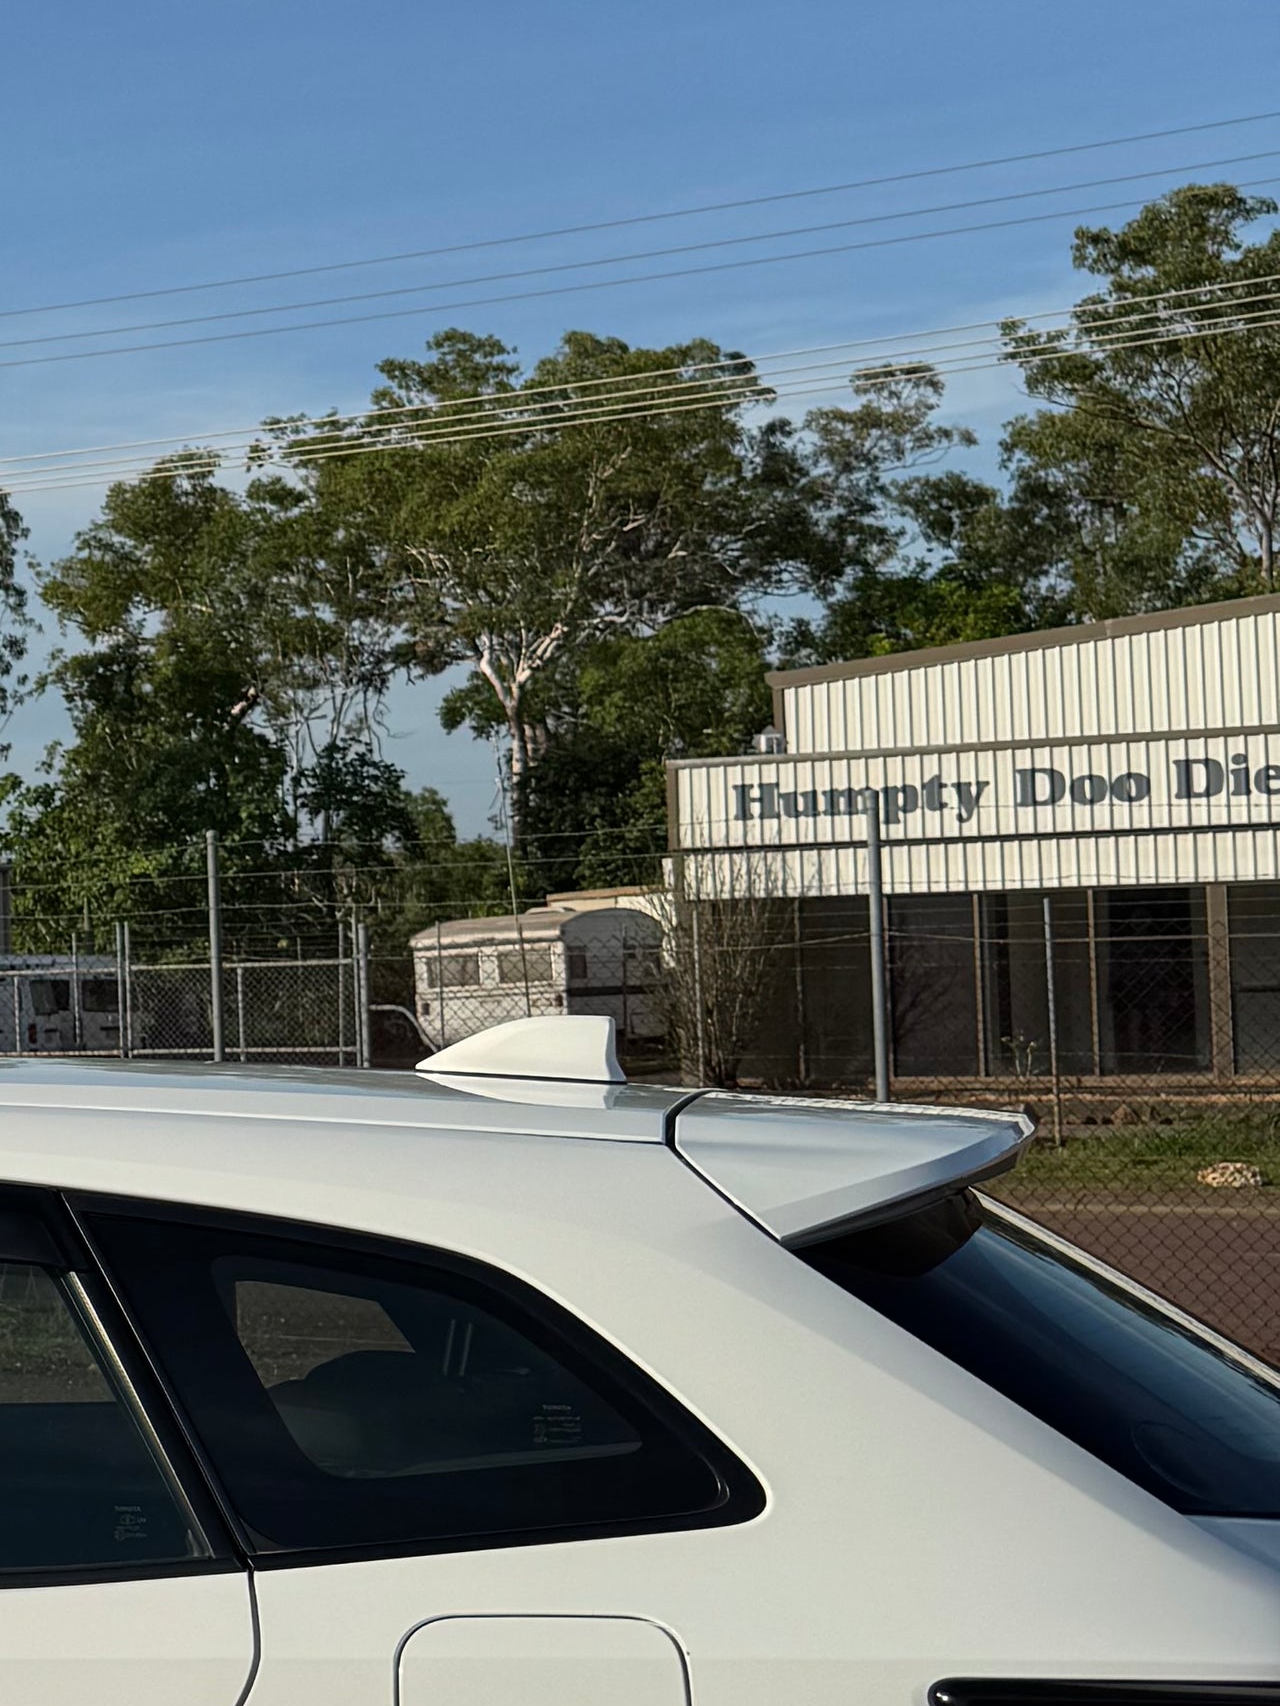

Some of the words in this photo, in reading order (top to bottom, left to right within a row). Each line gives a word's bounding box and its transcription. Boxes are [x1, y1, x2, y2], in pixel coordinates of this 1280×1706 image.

[732, 774, 990, 824] Humpty
[1016, 767, 1151, 807] Doo
[1173, 753, 1280, 799] Die
